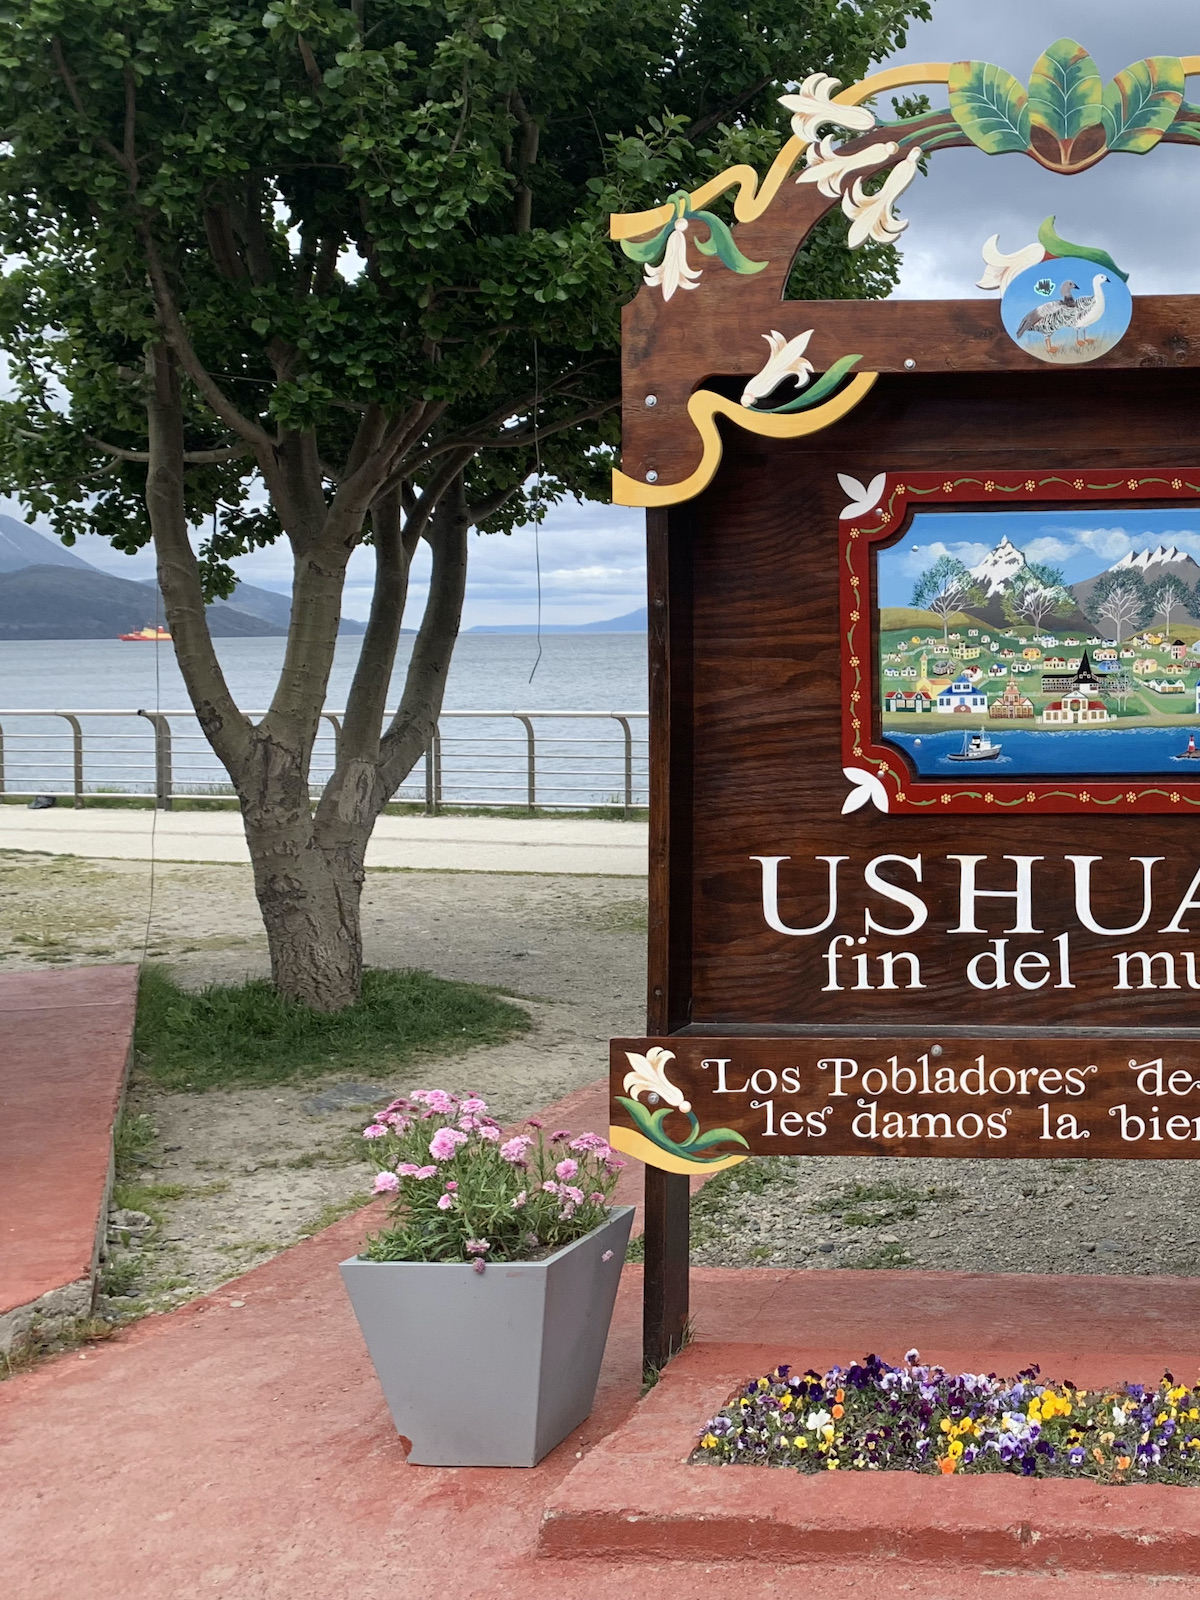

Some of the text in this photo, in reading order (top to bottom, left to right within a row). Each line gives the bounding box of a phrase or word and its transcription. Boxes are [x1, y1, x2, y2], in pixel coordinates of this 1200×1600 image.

[821, 934, 927, 992] fin
[966, 937, 1076, 990] del
[700, 1058, 801, 1095] Los
[816, 1053, 1098, 1097] Pobladores
[749, 1098, 834, 1138] les
[850, 1098, 1013, 1139] damos
[1037, 1103, 1091, 1140] la
